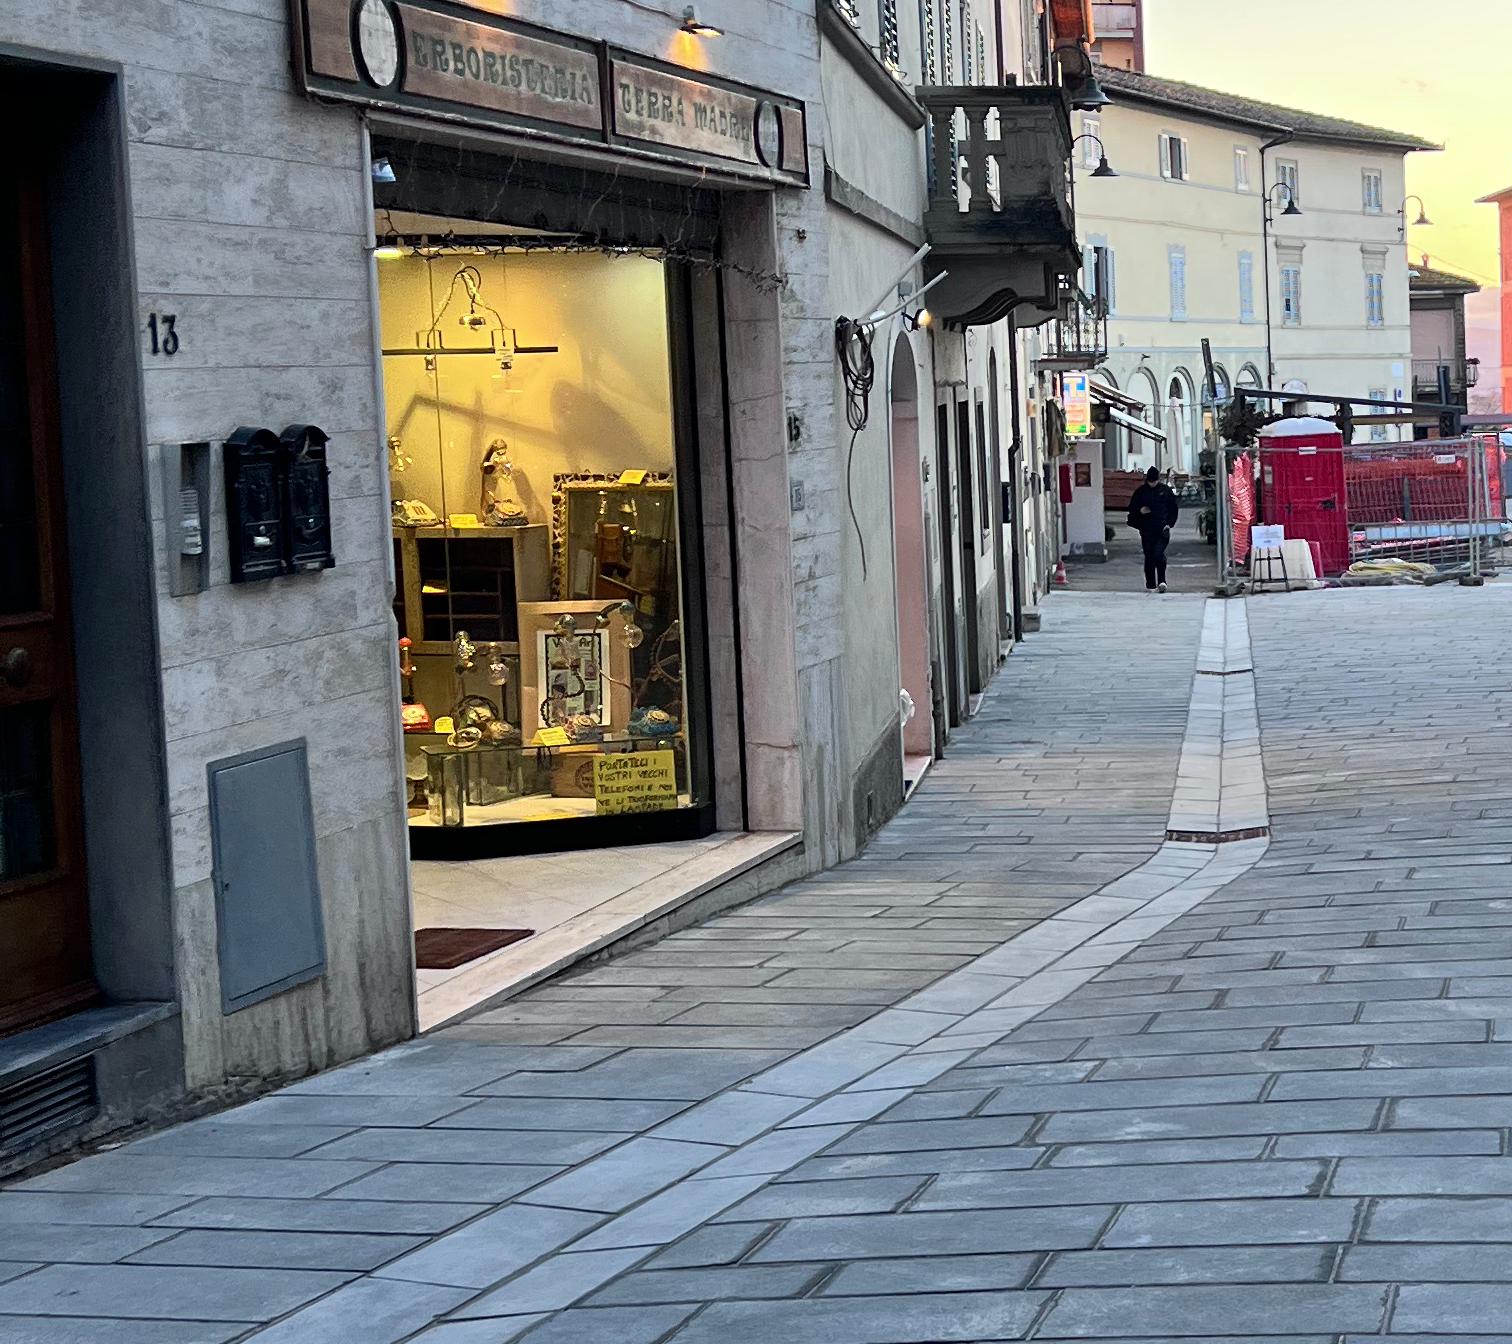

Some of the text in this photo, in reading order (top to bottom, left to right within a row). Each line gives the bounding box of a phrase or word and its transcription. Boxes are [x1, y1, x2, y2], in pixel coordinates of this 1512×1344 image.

[412, 31, 593, 104] ERBORISTERIA
[620, 83, 685, 126] TERRA
[147, 312, 178, 356] 13
[787, 415, 801, 442] 15
